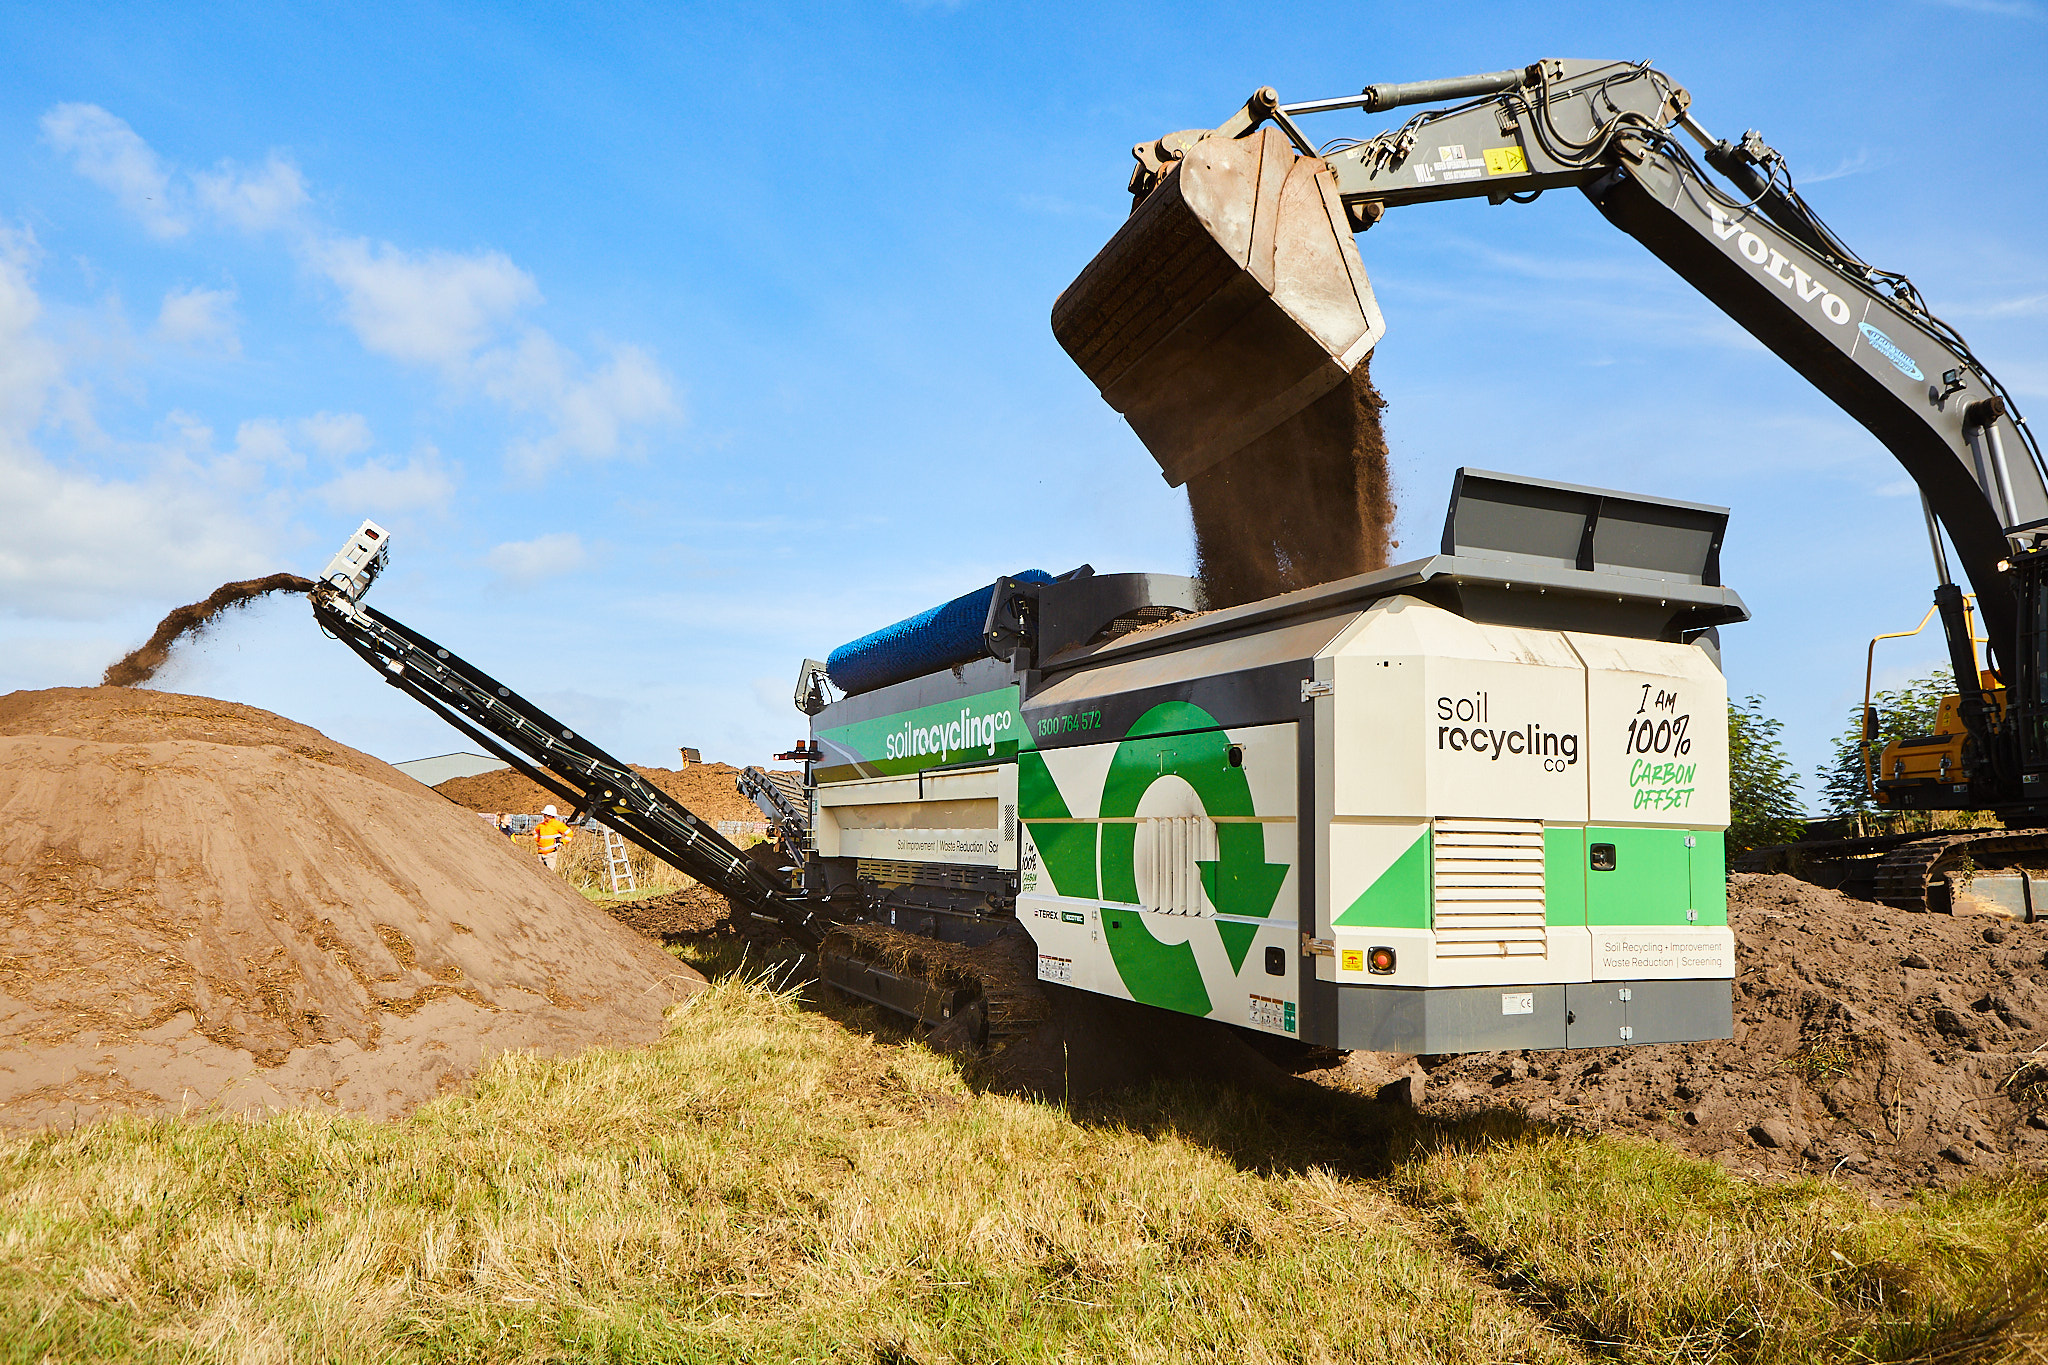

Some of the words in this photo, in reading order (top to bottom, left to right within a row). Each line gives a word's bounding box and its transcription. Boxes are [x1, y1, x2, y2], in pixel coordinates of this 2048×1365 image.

[1706, 201, 1851, 325] VOLVO
[1437, 691, 1488, 723] soil
[1636, 684, 1652, 715] I
[1655, 689, 1678, 714] AM
[1037, 717, 1059, 737] 1300
[1061, 714, 1080, 733] 764
[1081, 710, 1101, 730] 572
[1626, 714, 1691, 759] 100%
[1438, 723, 1578, 765] recycling
[1544, 758, 1566, 773] co
[1630, 758, 1697, 788] CARBON
[1633, 787, 1695, 811] OFFSET
[1602, 957, 1630, 968] Waste
[1632, 957, 1674, 967] Reduction
[1681, 956, 1722, 968] Screening
[1605, 942, 1621, 952] Soil
[1622, 942, 1663, 953] Recycling
[1670, 942, 1722, 953] Improvement
